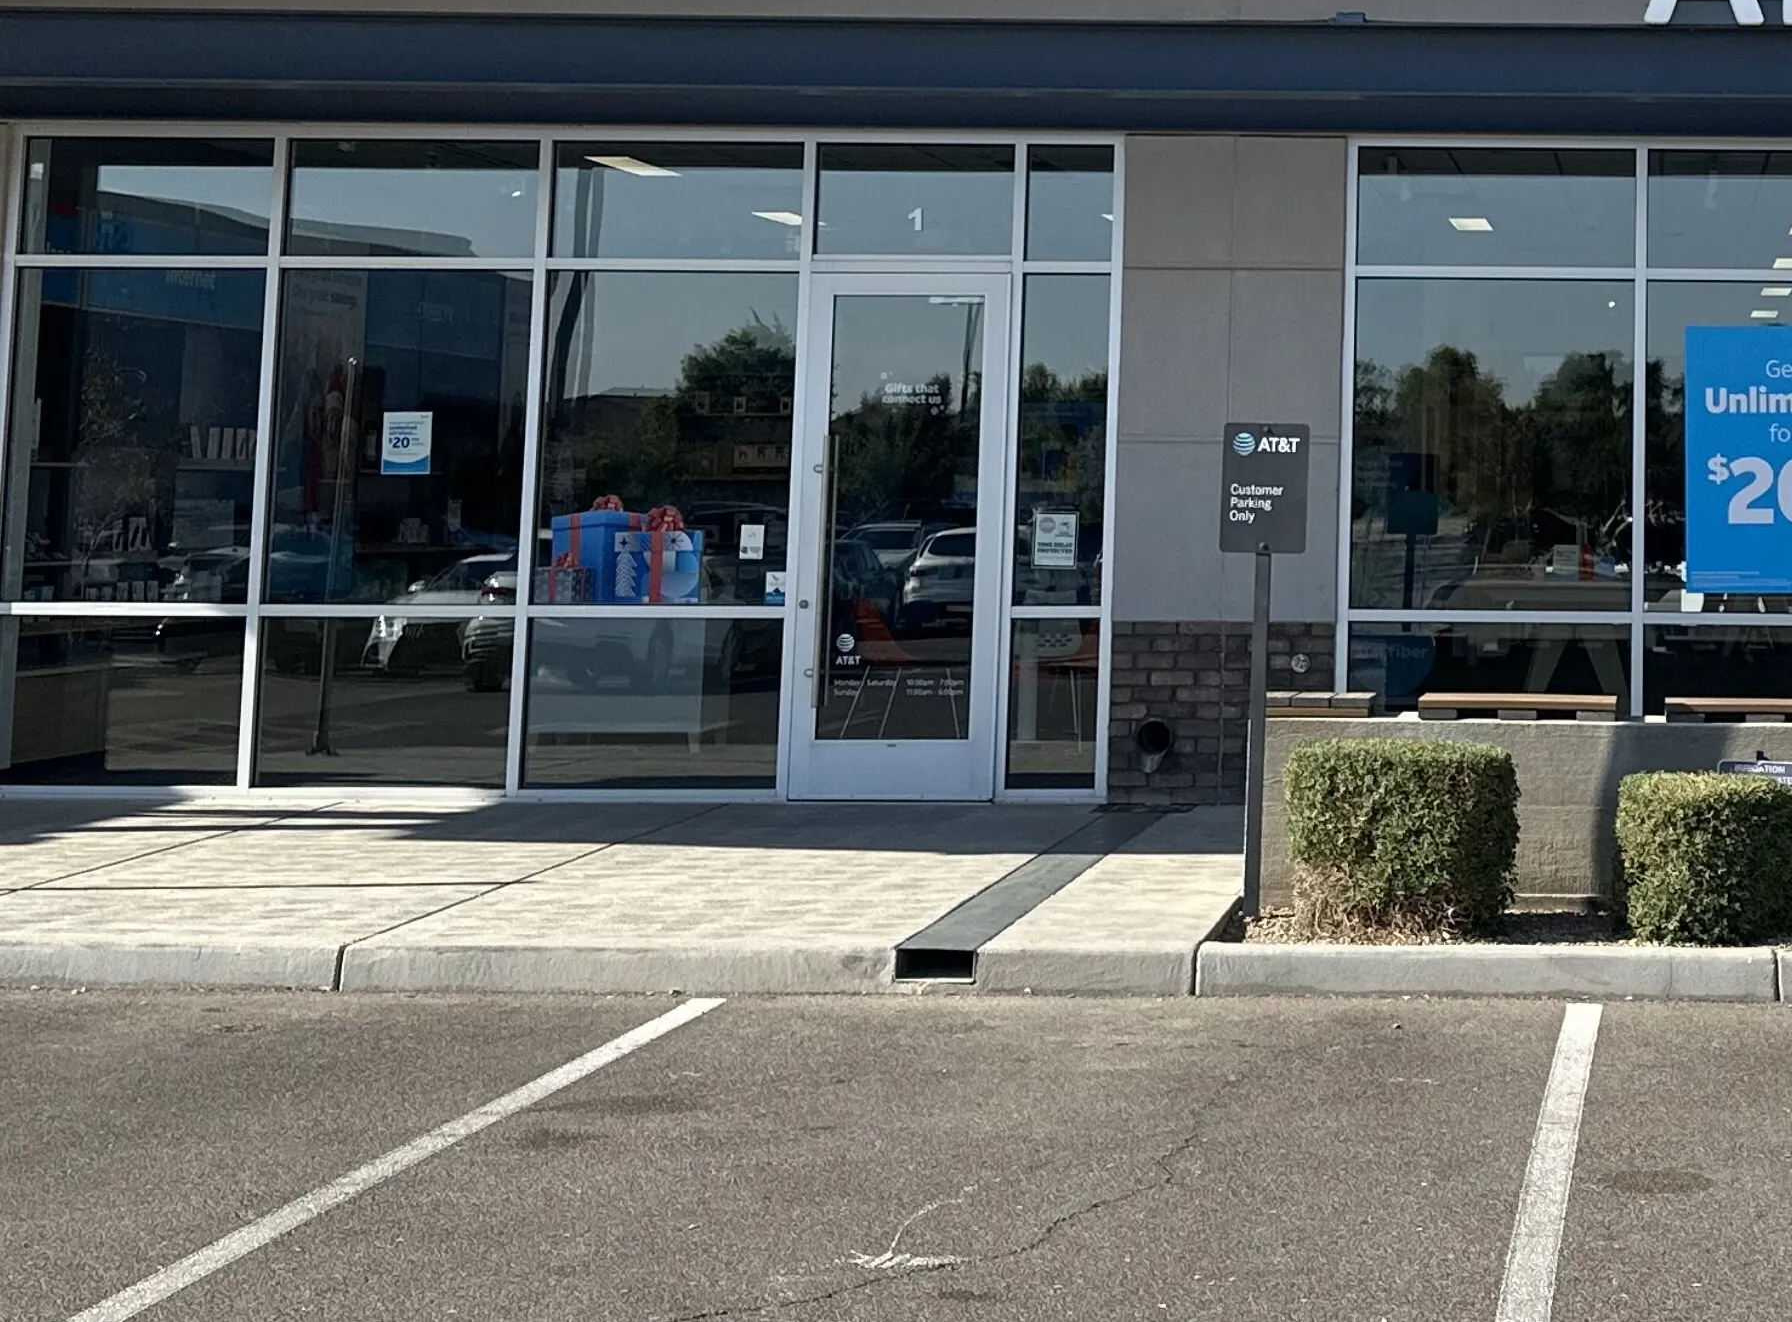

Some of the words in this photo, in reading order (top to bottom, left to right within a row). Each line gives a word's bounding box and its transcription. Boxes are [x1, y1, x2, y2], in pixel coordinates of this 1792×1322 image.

[907, 207, 923, 231] 1
[884, 382, 914, 394] Gifts
[915, 382, 940, 394] that
[881, 394, 927, 405] connect
[928, 395, 942, 405] us
[1257, 436, 1300, 453] AT&T
[1230, 483, 1284, 496] Customer
[1230, 496, 1273, 512] Parking
[1229, 509, 1256, 525] Only
[835, 655, 862, 666] AT&T
